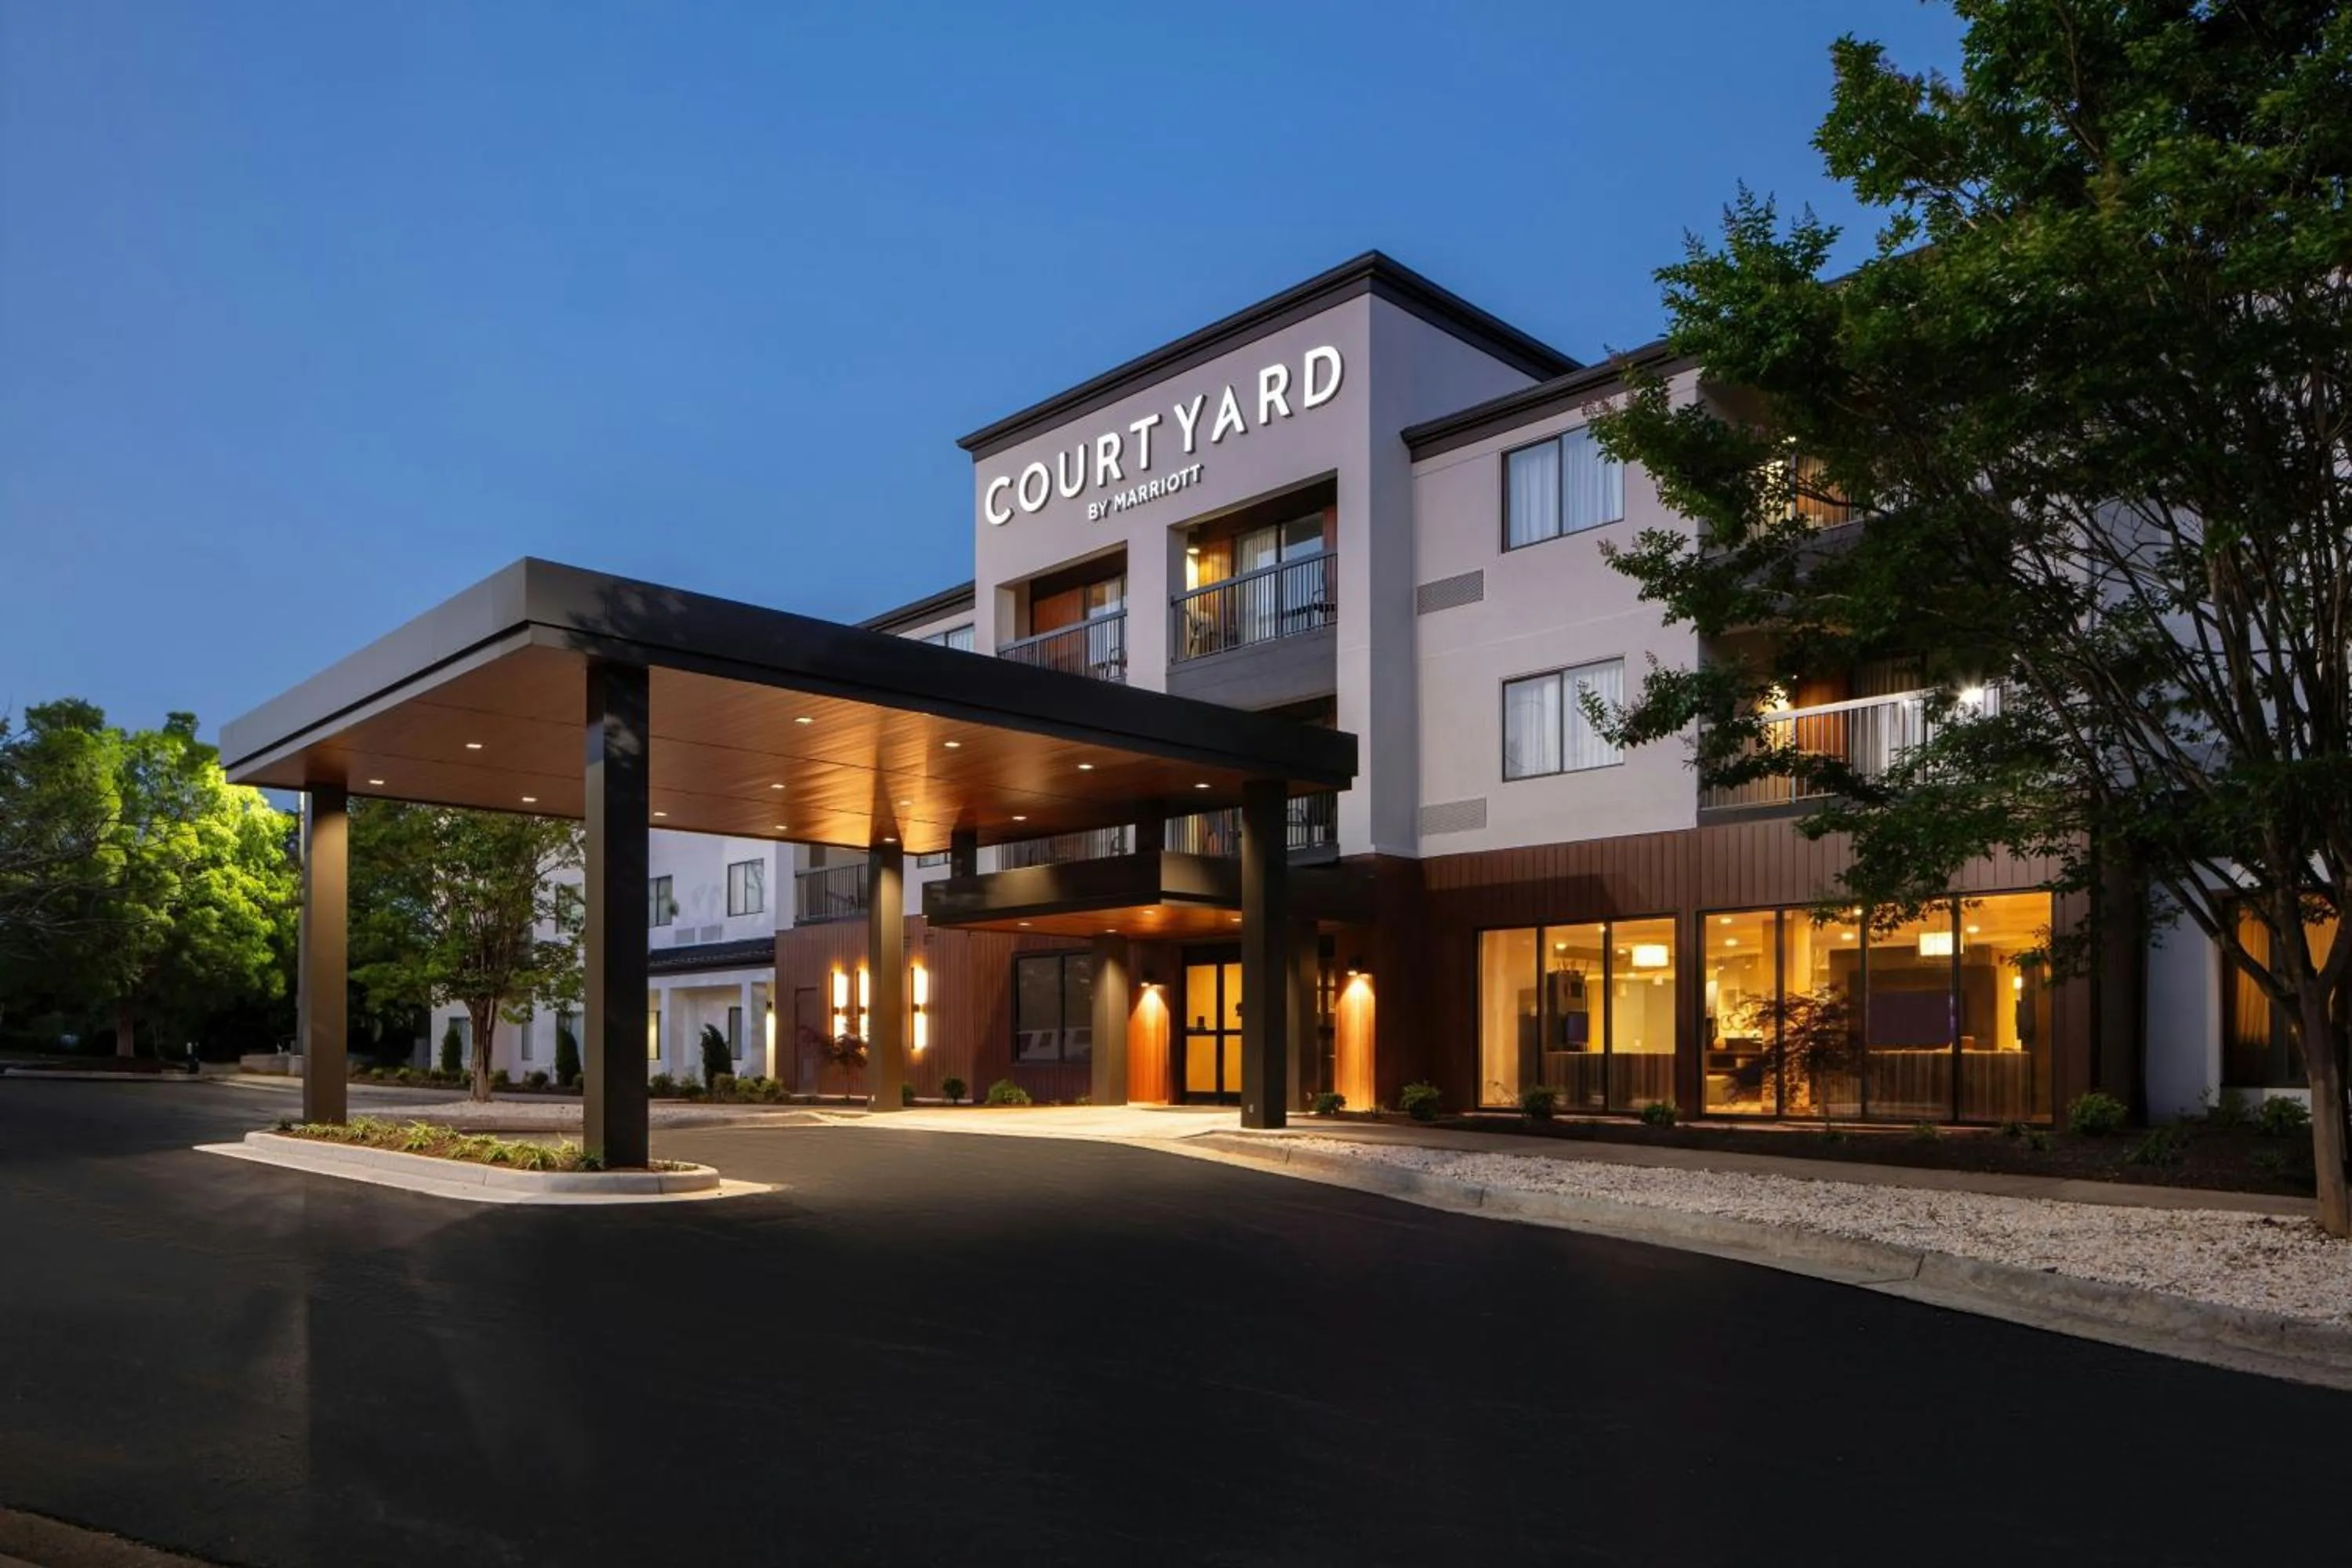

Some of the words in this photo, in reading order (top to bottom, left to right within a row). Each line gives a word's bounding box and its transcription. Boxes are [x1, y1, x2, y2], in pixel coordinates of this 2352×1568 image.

[985, 346, 1342, 524] COURTYARD
[1087, 499, 1109, 520] BY
[1114, 463, 1203, 510] MARRIOTT
